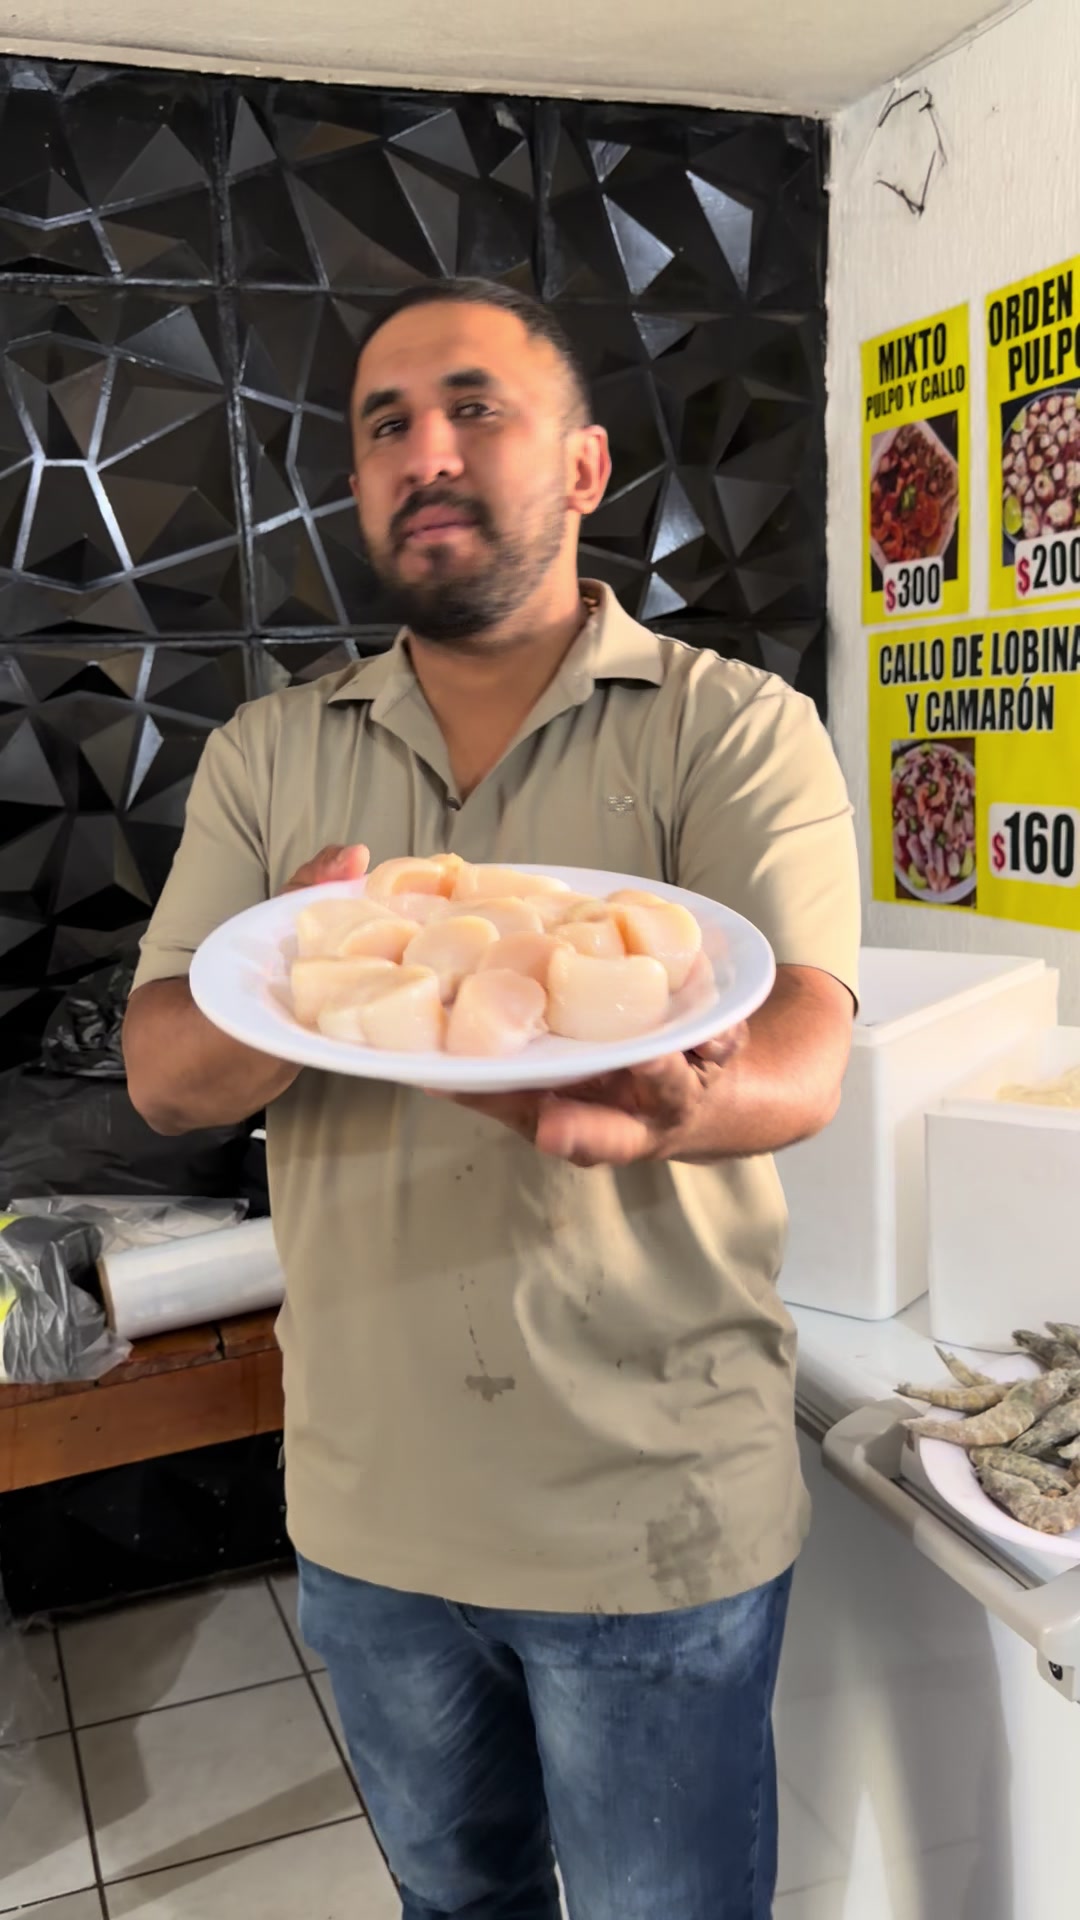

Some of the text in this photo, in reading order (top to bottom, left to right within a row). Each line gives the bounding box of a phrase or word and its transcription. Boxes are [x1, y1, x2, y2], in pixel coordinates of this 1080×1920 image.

[987, 270, 1073, 347] ORDEN
[878, 322, 947, 385] MIXTO
[866, 364, 966, 422] PULPO Y CALLO
[884, 562, 941, 613] $300
[1017, 537, 1080, 596] $200
[880, 624, 1080, 686] CALLO DE LOBINA
[906, 677, 1055, 733] Y CAMARÓN
[992, 811, 1075, 878] $160
